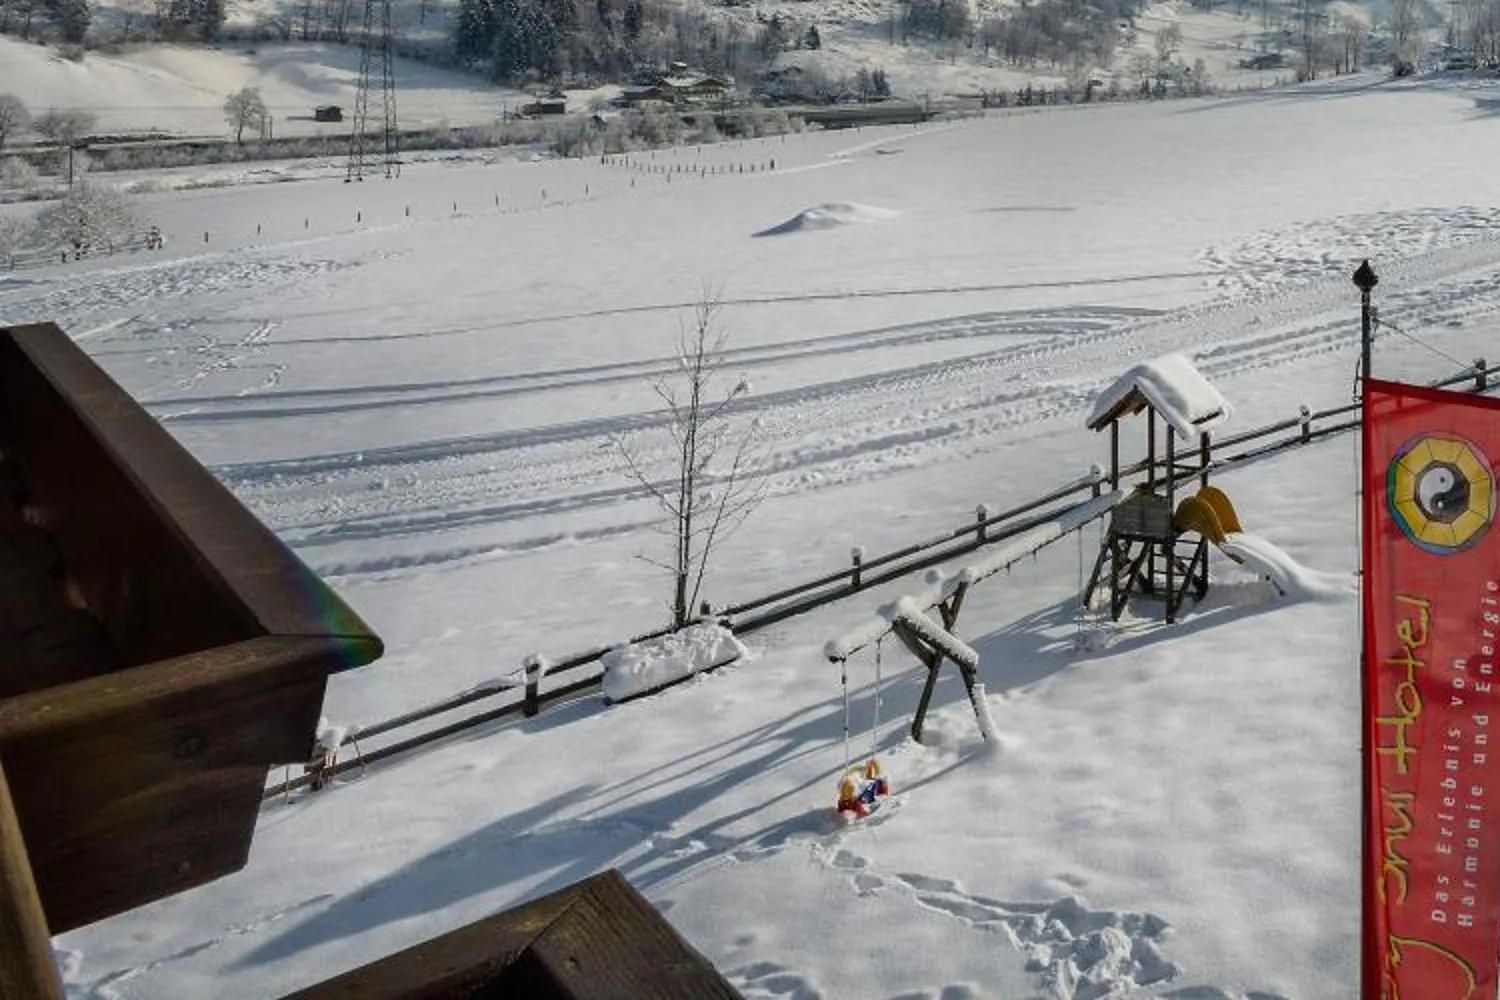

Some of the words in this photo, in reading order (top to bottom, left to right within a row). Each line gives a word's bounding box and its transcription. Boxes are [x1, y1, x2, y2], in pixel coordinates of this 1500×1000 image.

[1375, 594, 1430, 775] Hotel
[1451, 658, 1467, 707] von
[1475, 580, 1500, 693] Energie
[1436, 727, 1461, 854] Erlebnis
[1471, 714, 1489, 764] und
[1431, 874, 1450, 923] Das
[1457, 784, 1484, 927] Harmonie
